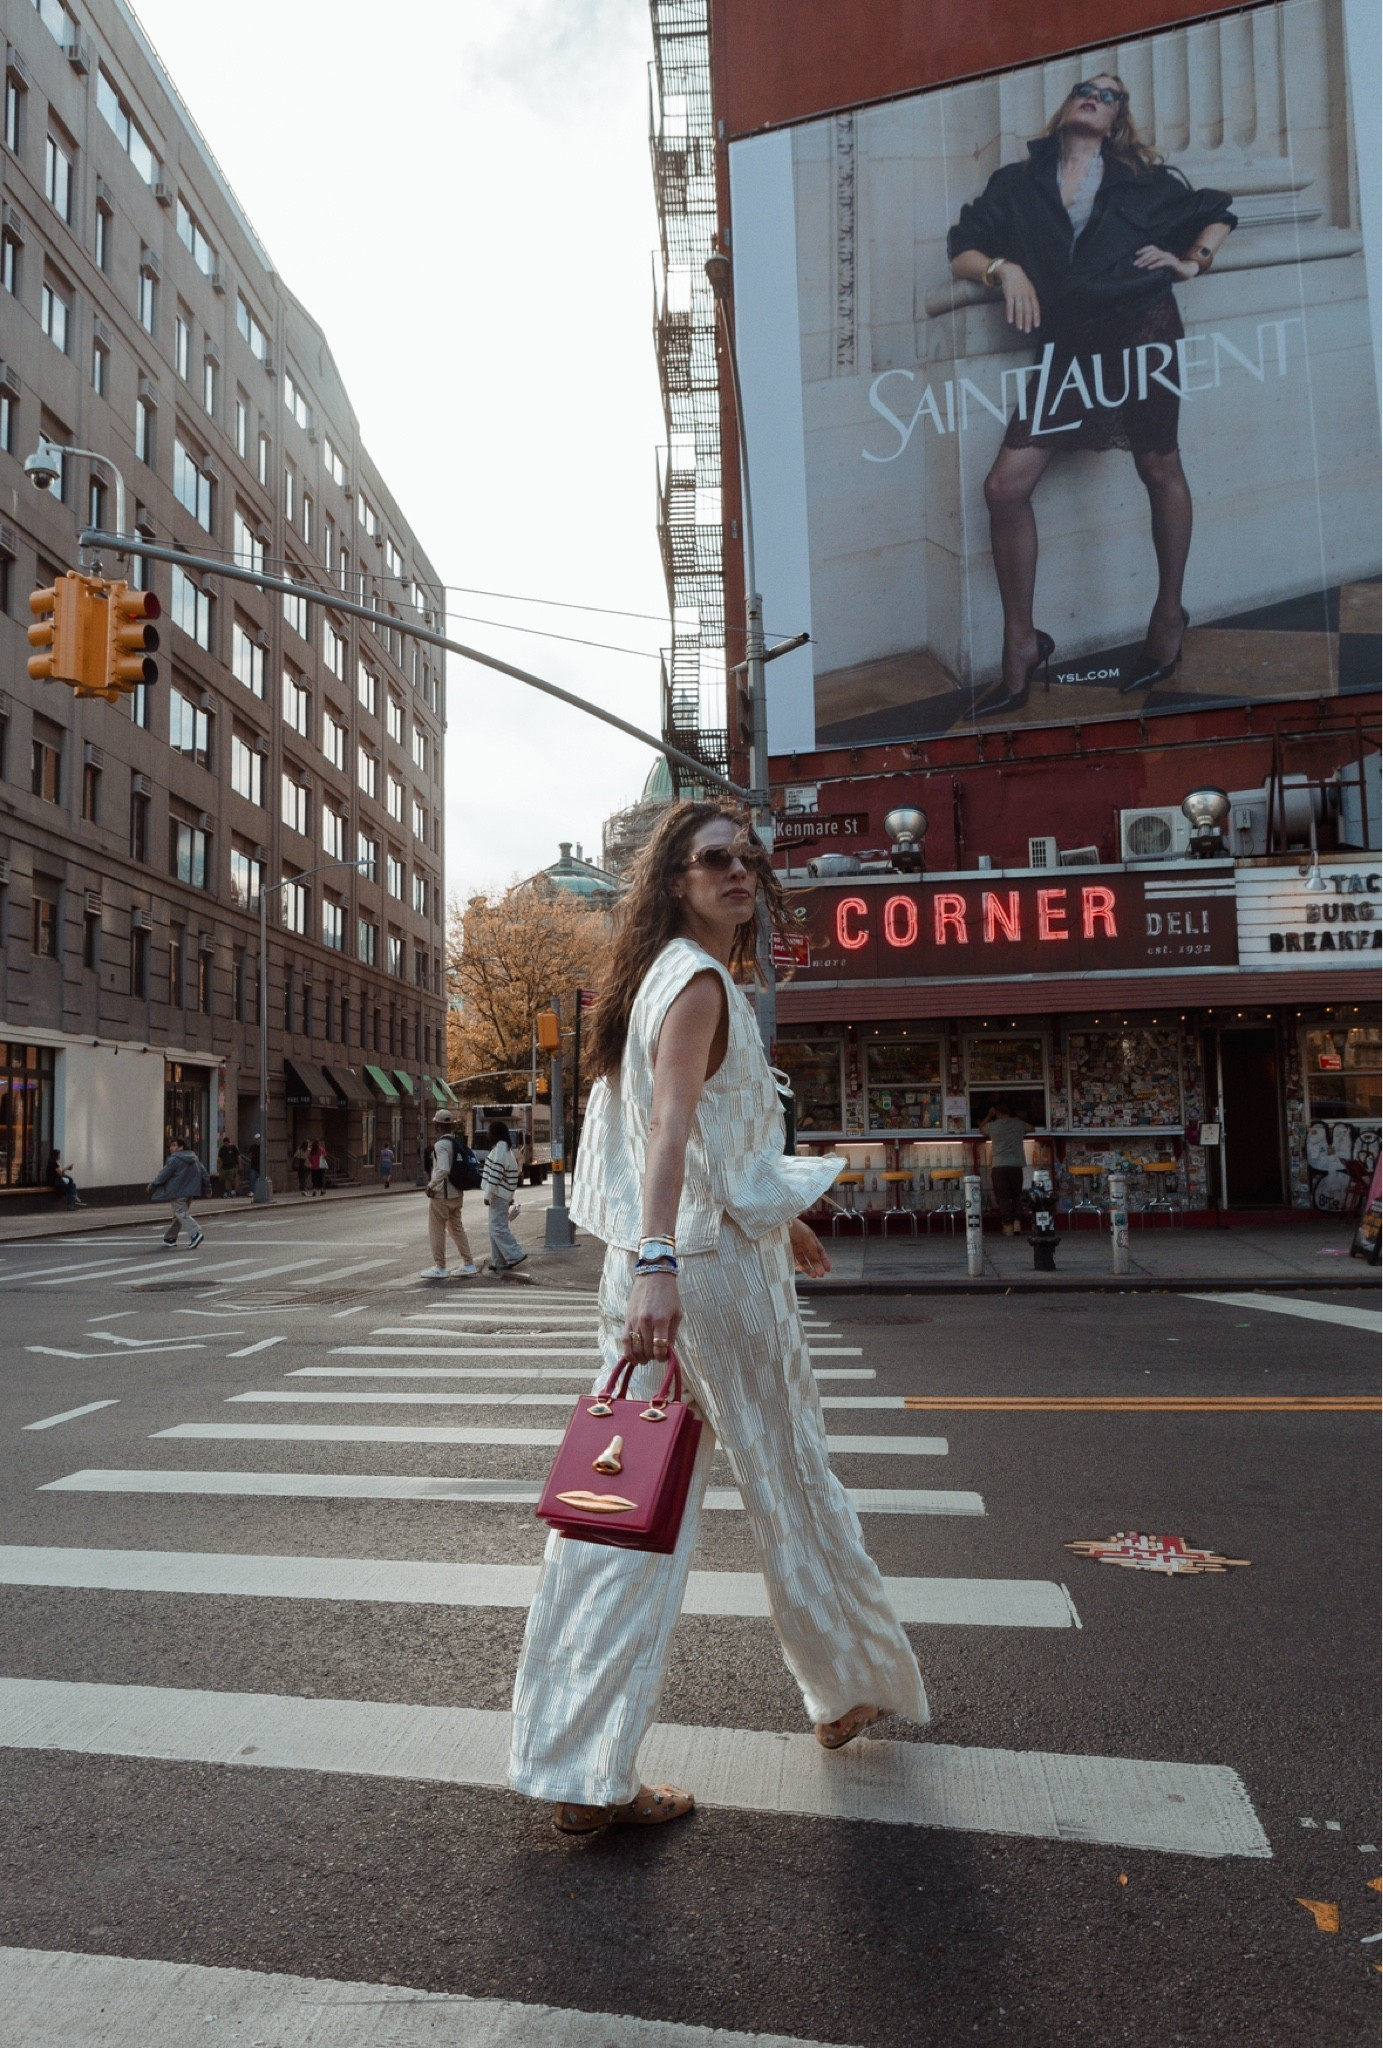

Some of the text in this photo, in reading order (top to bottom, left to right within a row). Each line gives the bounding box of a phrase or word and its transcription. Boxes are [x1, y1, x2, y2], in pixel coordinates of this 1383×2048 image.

[1056, 667, 1120, 684] YSL.COM
[776, 818, 859, 837] Kenmare St
[836, 885, 1119, 950] CORNER
[1146, 910, 1210, 936] DELI
